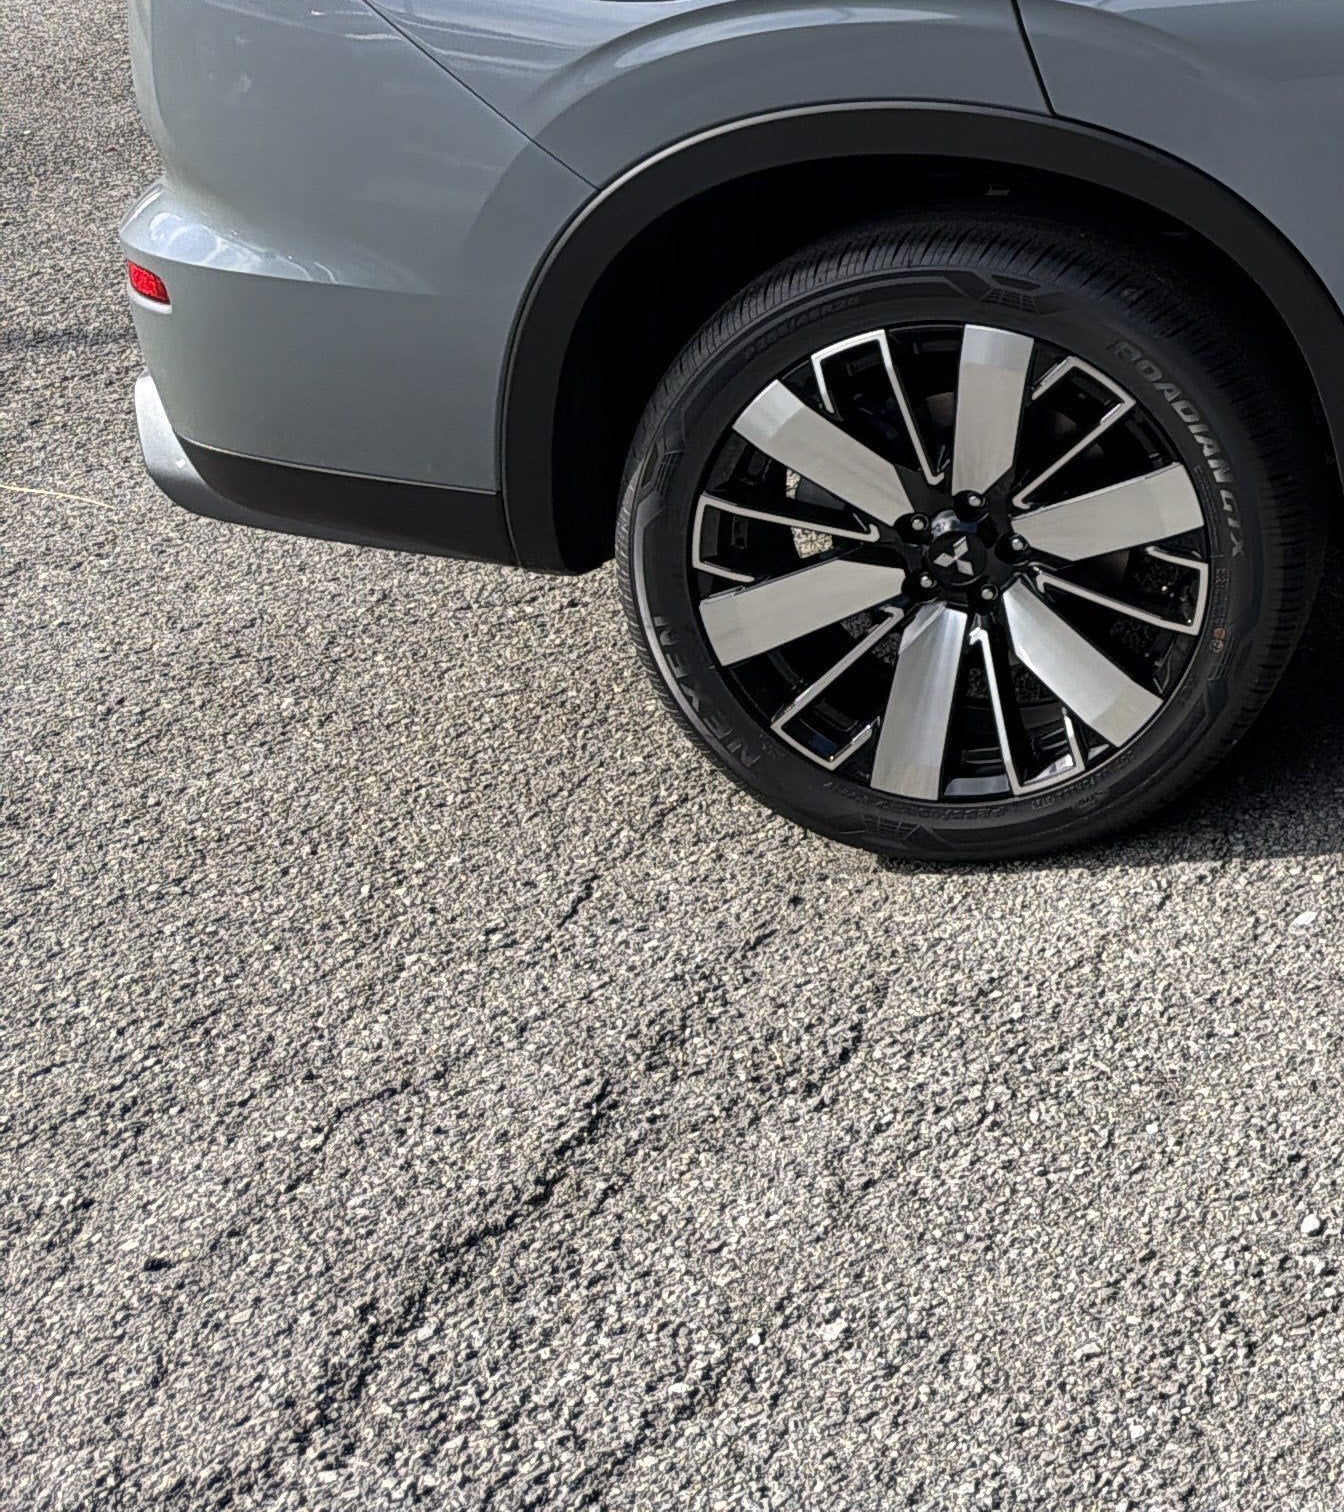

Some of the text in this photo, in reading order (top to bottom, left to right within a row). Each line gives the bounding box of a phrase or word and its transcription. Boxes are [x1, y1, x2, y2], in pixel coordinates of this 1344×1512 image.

[1108, 338, 1246, 558] ROADIAN GTX
[652, 614, 763, 768] NEXEN
